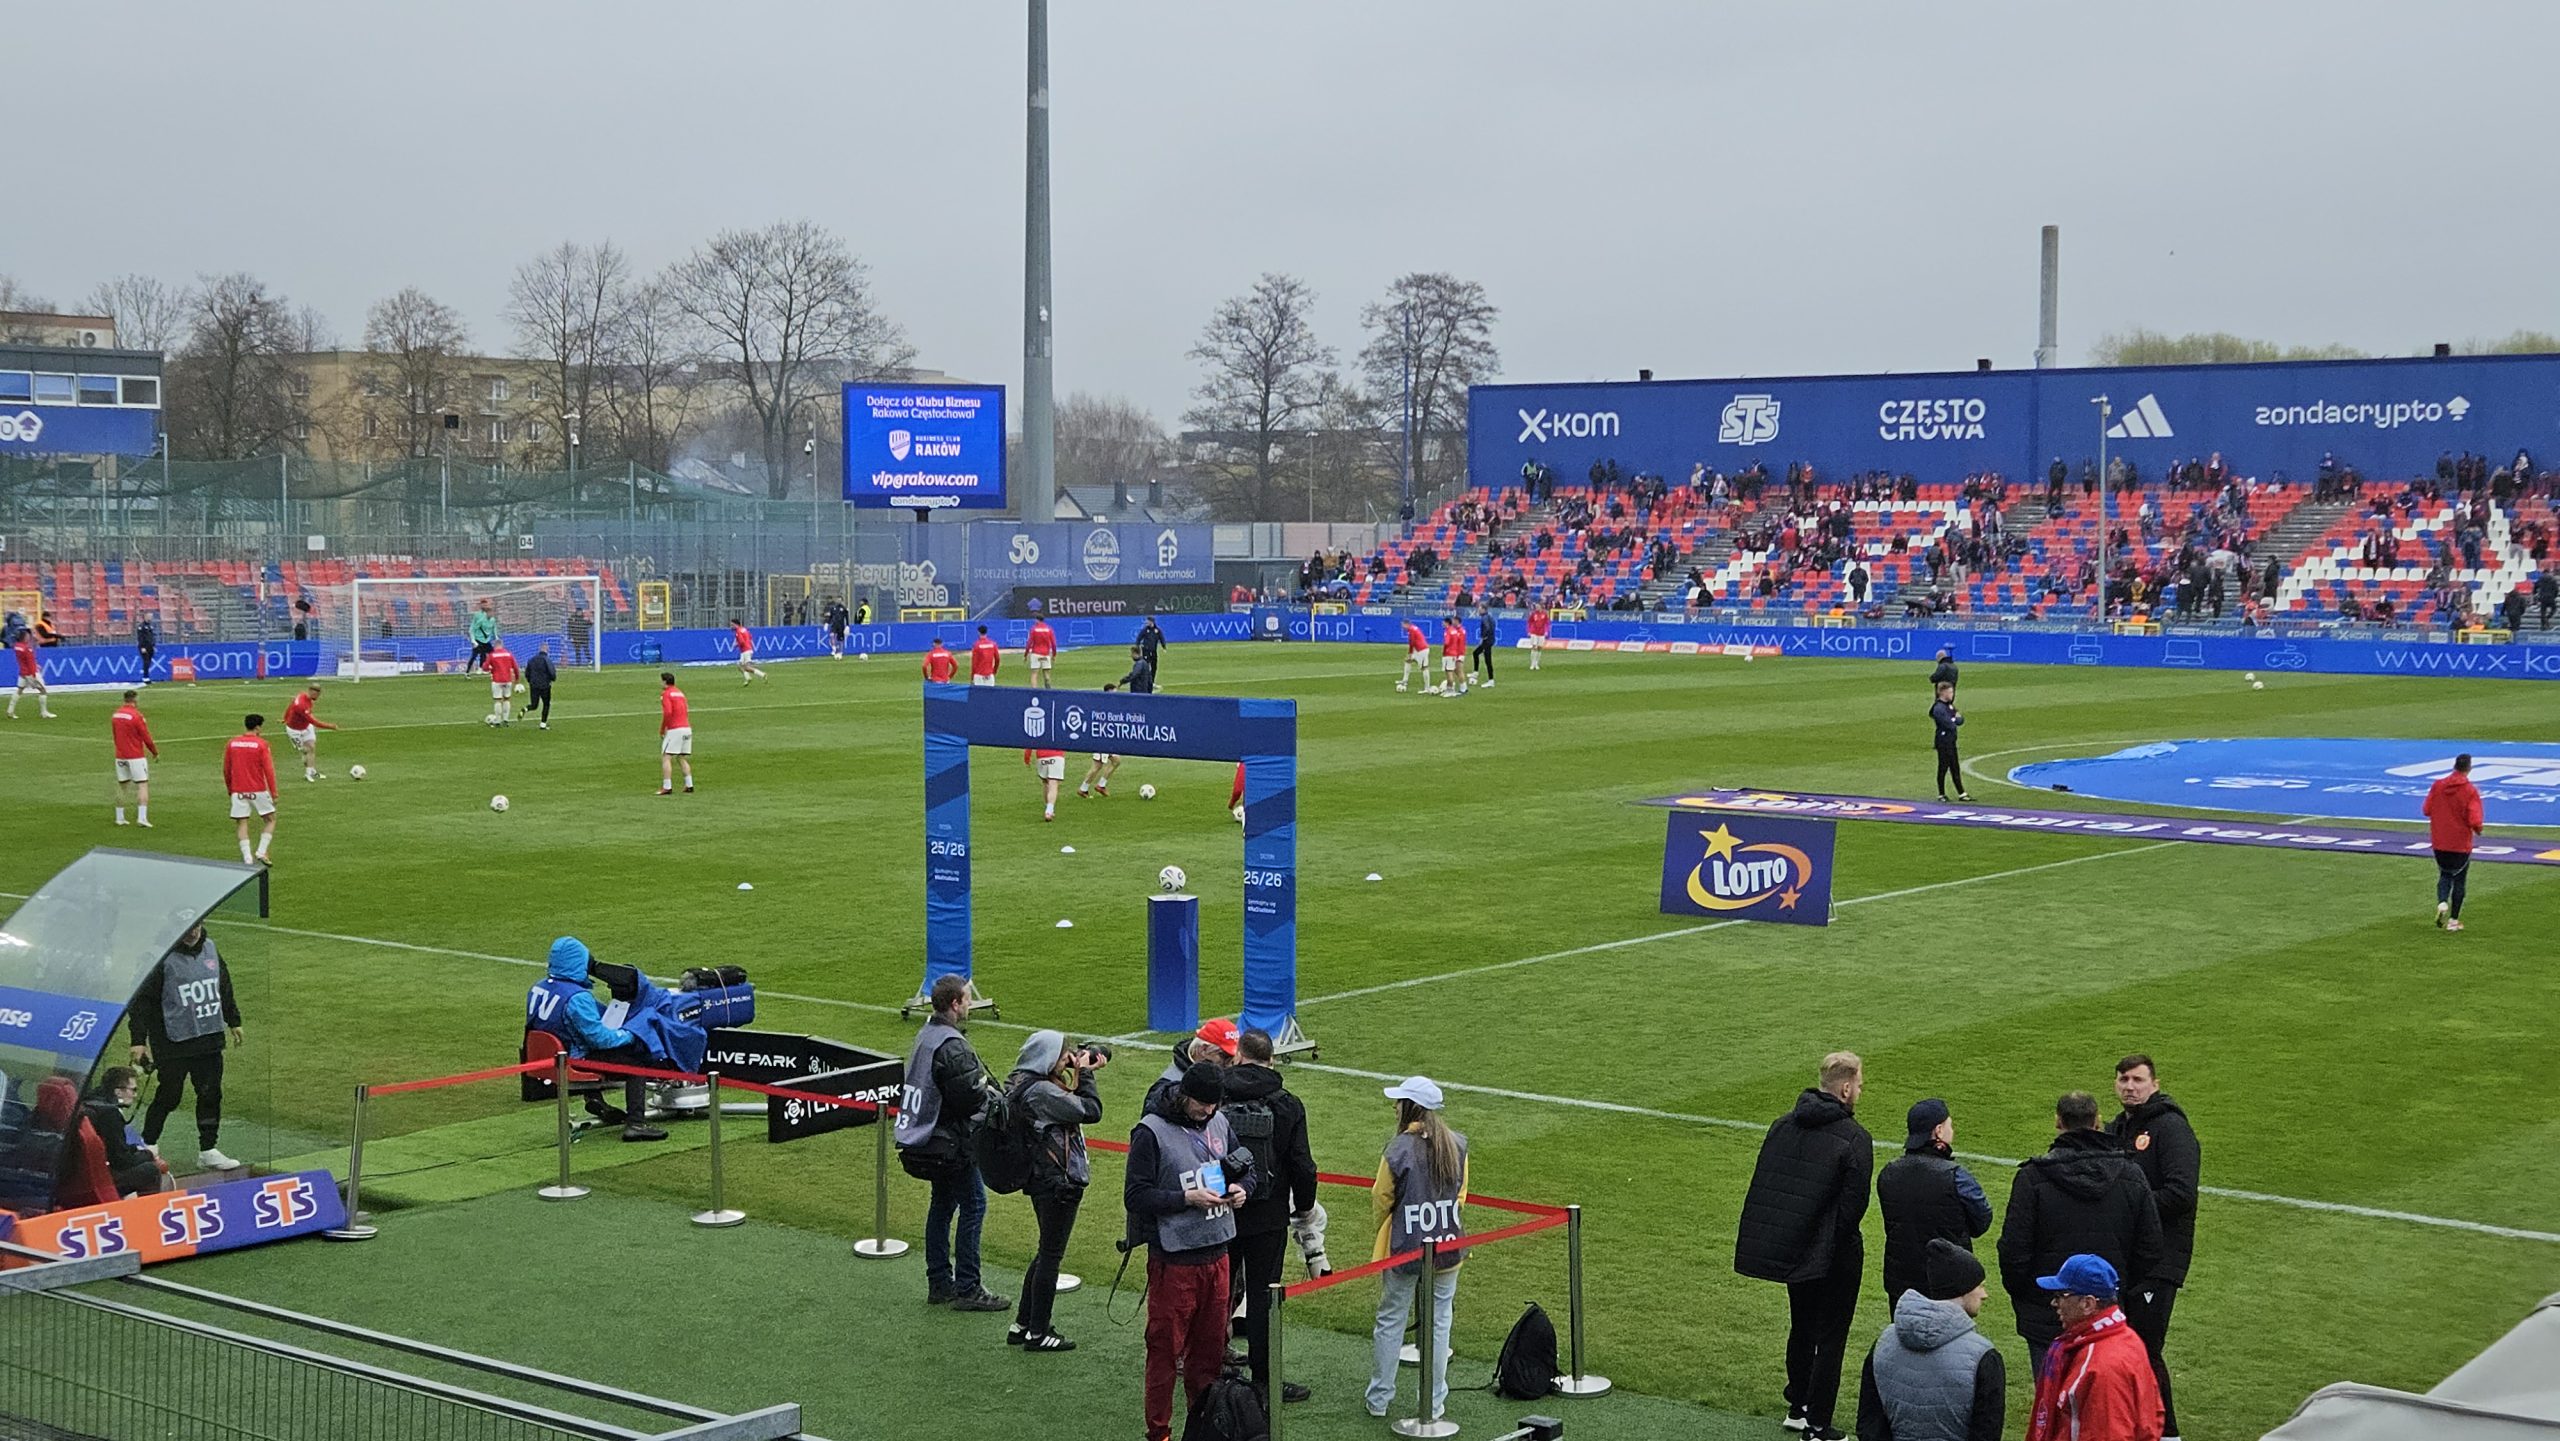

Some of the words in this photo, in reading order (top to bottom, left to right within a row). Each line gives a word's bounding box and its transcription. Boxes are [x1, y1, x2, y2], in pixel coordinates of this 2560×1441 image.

[867, 395, 900, 408] Dołącz
[902, 396, 914, 406] do
[916, 396, 944, 407] Klubu
[946, 396, 981, 408] Biznesu
[872, 408, 909, 418] Rakowa
[1718, 394, 1781, 446] STS
[2255, 399, 2443, 429] zondacrypto
[915, 441, 961, 456] RAKÓW
[872, 471, 978, 488] vip@rakow.com
[1158, 545, 1178, 567] EP
[1138, 568, 1196, 580] Nieruchomości
[899, 587, 946, 602] arena
[1708, 630, 1911, 657] www.x-kom.pl
[1091, 711, 1106, 721] PKO
[1107, 712, 1124, 722] Bank
[1125, 712, 1146, 723] Polski
[1091, 722, 1177, 742] EKSTRAKLASA
[930, 840, 966, 857] 25/26
[1243, 870, 1283, 888] 25/26
[1712, 857, 1788, 897] LOTTO
[195, 1001, 221, 1019] 117
[528, 986, 560, 1021] TV
[59, 1010, 98, 1041] STS
[706, 1049, 746, 1065] LIVE
[748, 1052, 798, 1069] PARK
[253, 1176, 318, 1229] STS
[159, 1194, 224, 1246] STS
[56, 1212, 128, 1258] STS
